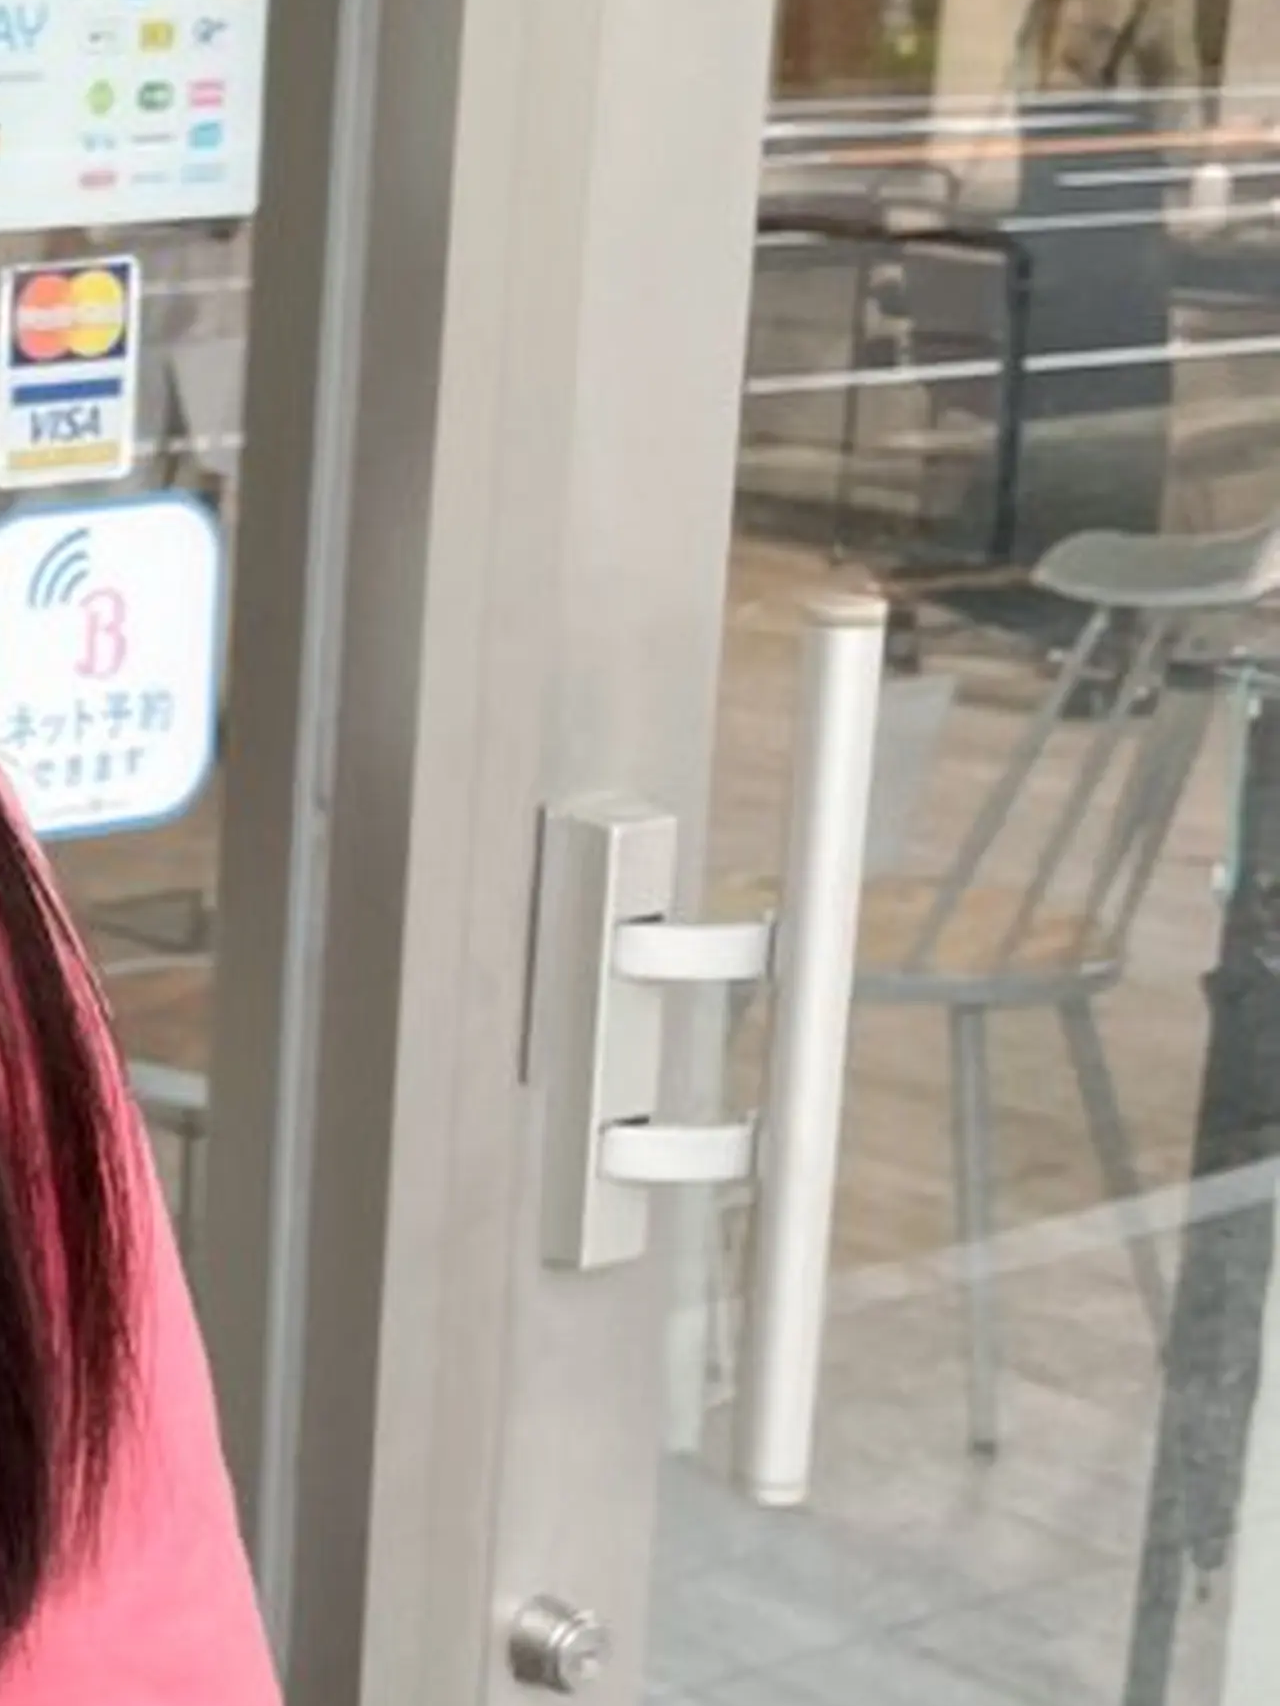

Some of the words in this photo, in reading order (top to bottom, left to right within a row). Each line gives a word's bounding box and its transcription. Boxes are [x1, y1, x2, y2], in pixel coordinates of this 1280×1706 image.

[29, 405, 102, 445] VISA
[2, 688, 175, 749] ネット予約
[33, 746, 145, 790] できます
